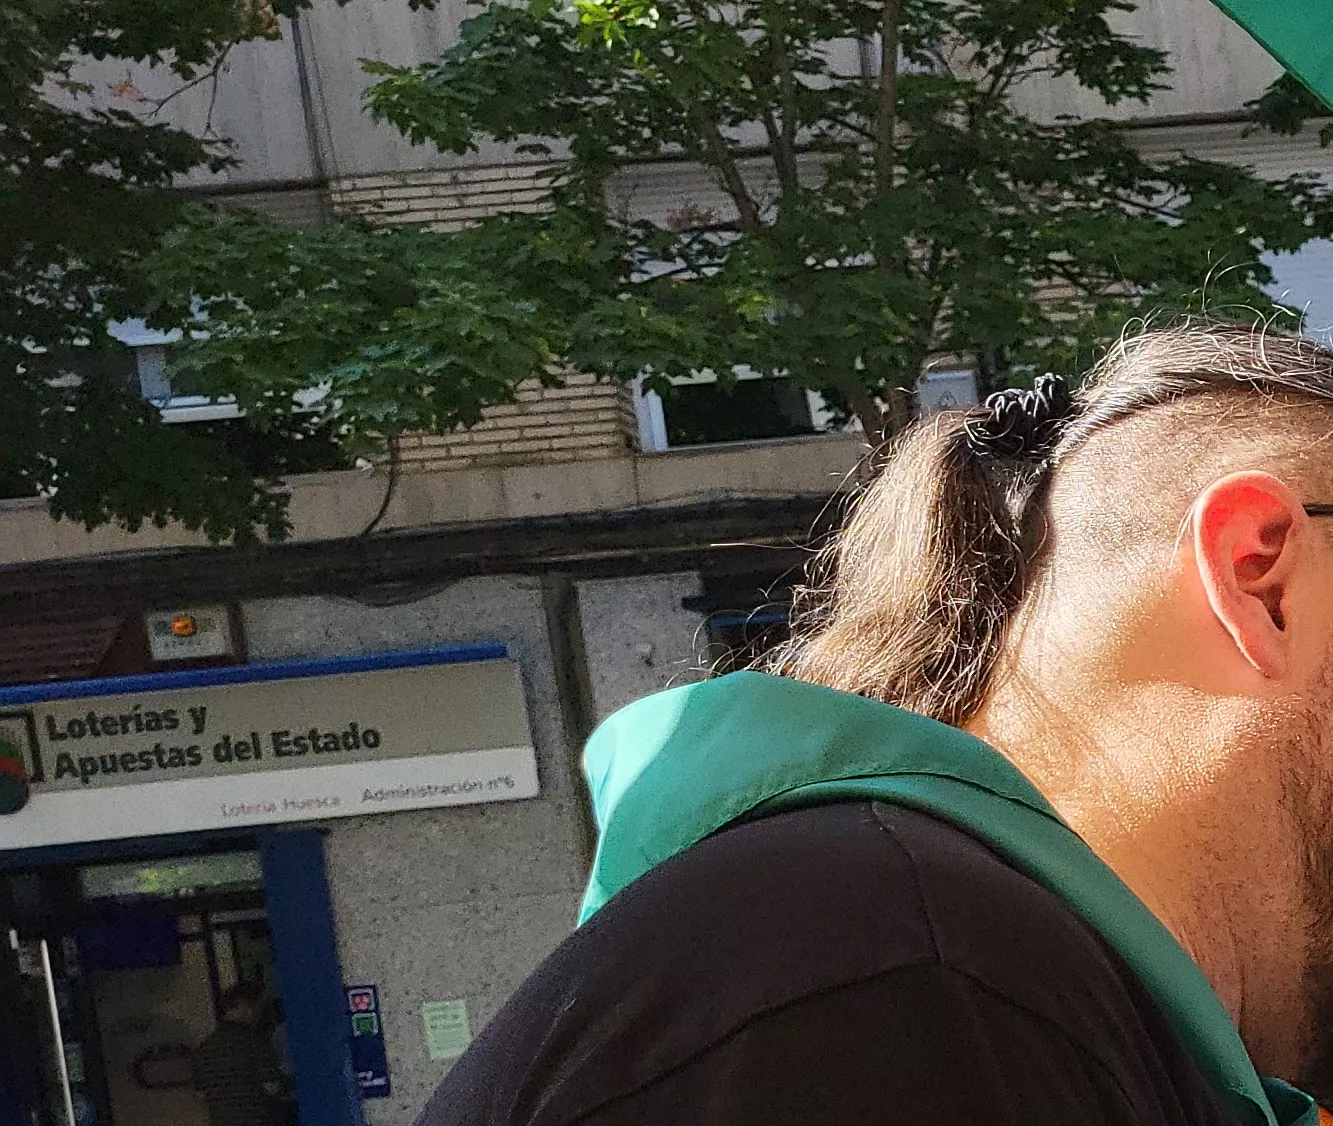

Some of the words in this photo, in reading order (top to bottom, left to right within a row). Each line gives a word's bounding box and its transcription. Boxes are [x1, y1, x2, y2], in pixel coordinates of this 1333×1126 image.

[46, 703, 180, 741] Loterías
[187, 705, 207, 735] y
[54, 742, 203, 785] Apuestas
[212, 731, 262, 763] del
[270, 721, 381, 758] Estado
